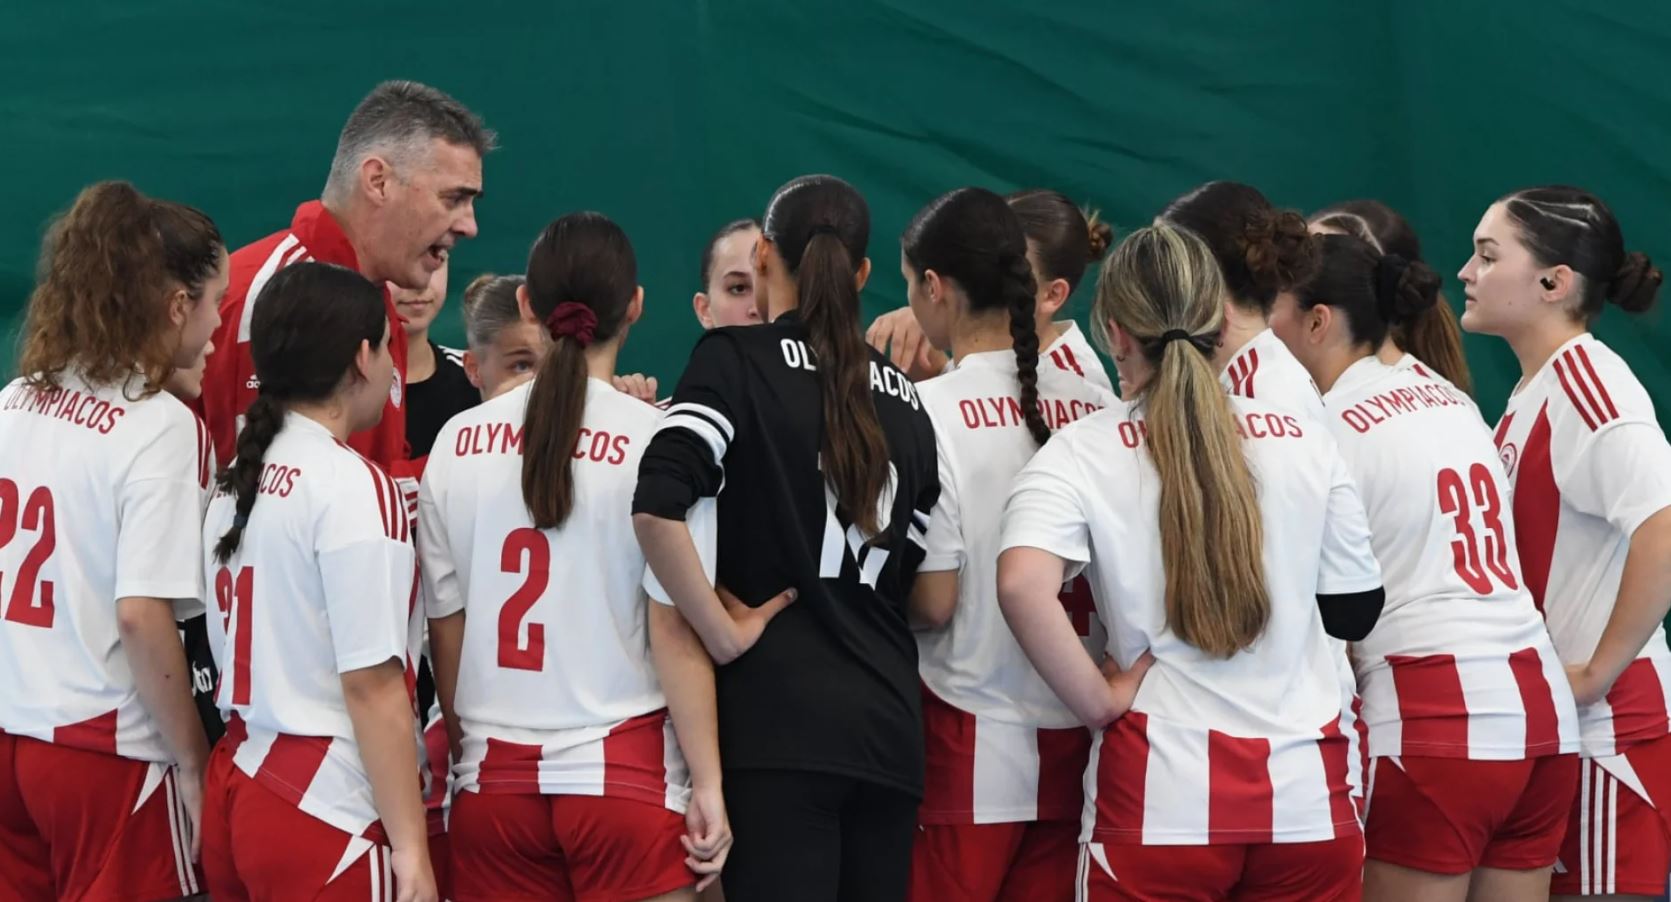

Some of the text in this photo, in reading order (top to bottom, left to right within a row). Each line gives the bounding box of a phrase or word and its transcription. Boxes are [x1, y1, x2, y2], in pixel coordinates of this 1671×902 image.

[780, 338, 919, 410] OLACOS
[959, 396, 1105, 429] OLYMIAC
[1118, 413, 1303, 449] OACOS
[1341, 384, 1466, 433] OLYMPIACO
[455, 423, 630, 465] OLYMCOS
[1437, 462, 1518, 595] 33
[498, 527, 550, 671] 2
